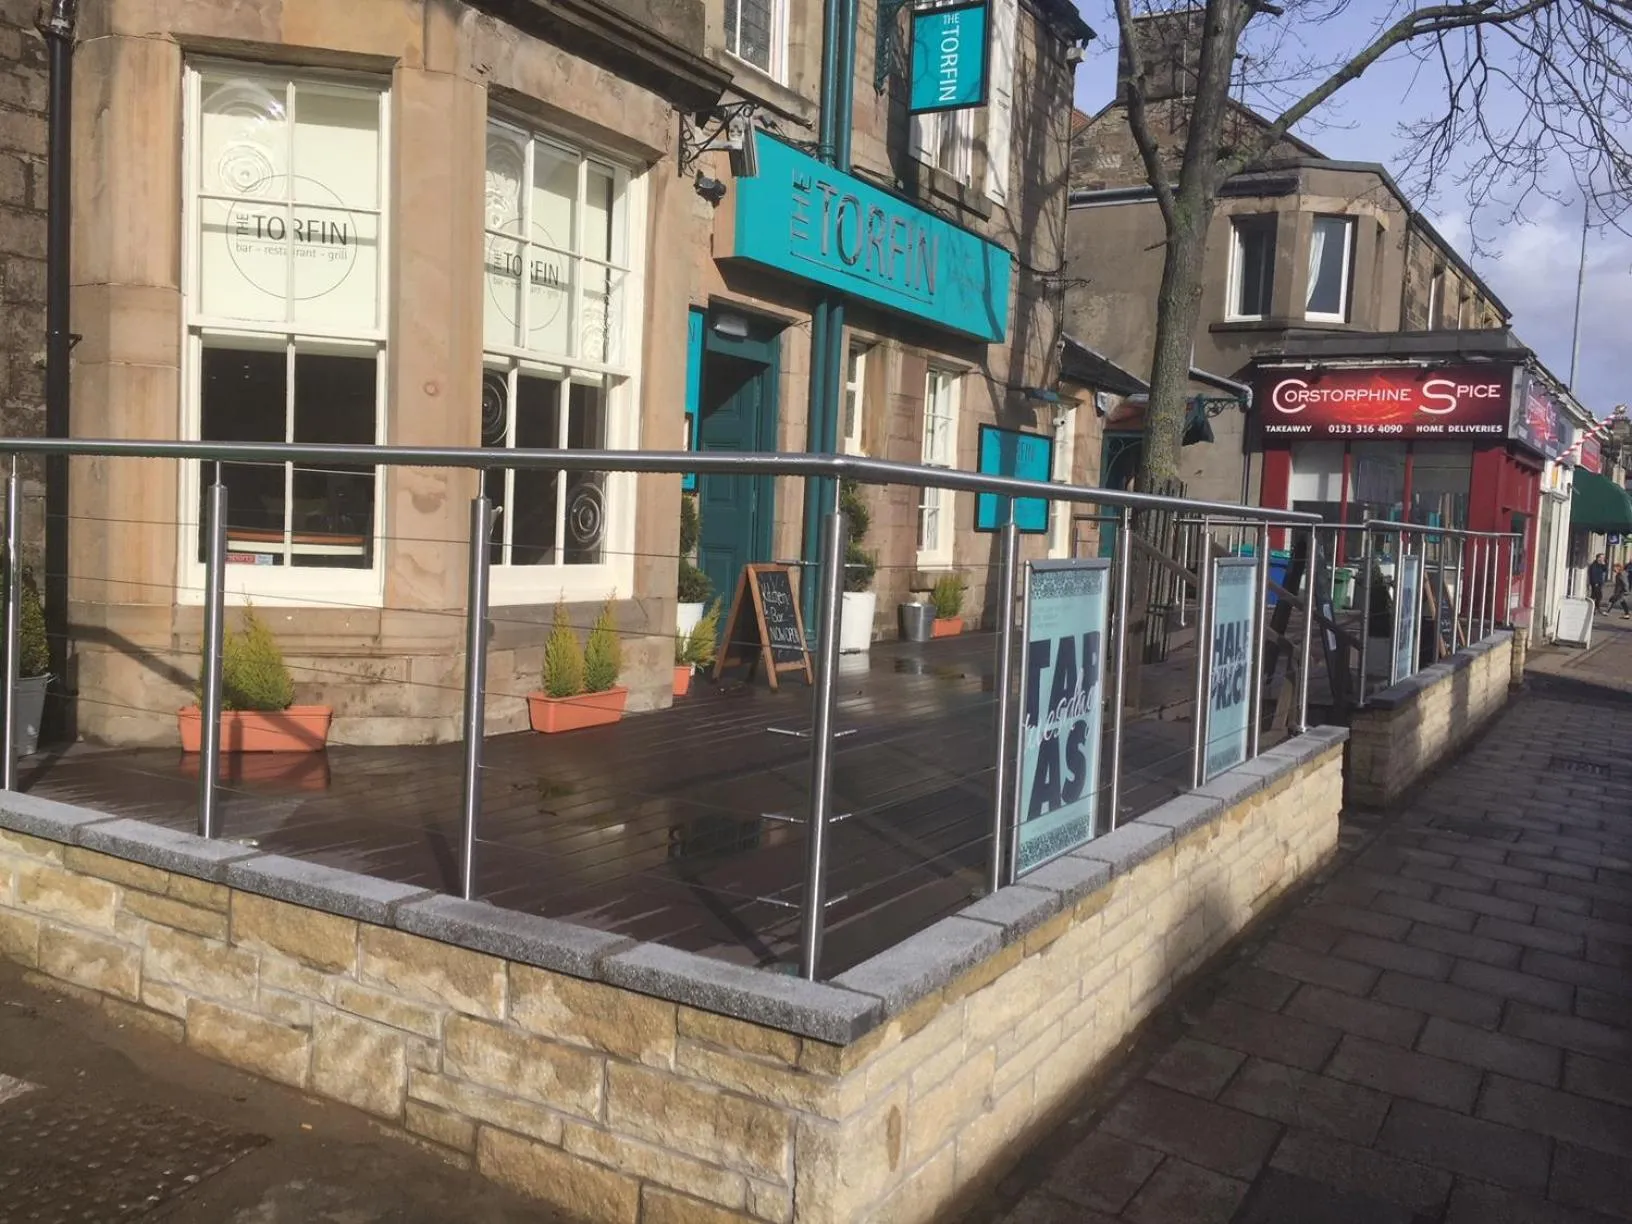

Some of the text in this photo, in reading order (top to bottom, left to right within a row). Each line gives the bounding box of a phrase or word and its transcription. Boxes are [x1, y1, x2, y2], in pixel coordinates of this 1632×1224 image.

[938, 12, 960, 102] THE TORFIN
[791, 169, 813, 242] THE
[235, 213, 249, 236] THE
[251, 214, 348, 246] TORFIN
[815, 180, 940, 296] TORFIN
[235, 243, 348, 261] bar restarant grill
[504, 252, 559, 286] TOFIN
[1272, 378, 1412, 414] CORSTORPHINE
[1418, 379, 1501, 414] SPICE
[1265, 424, 1503, 434] TAKEAWAY 0131 316 4090 HOME DELIVERIES
[1026, 719, 1087, 821] AS
